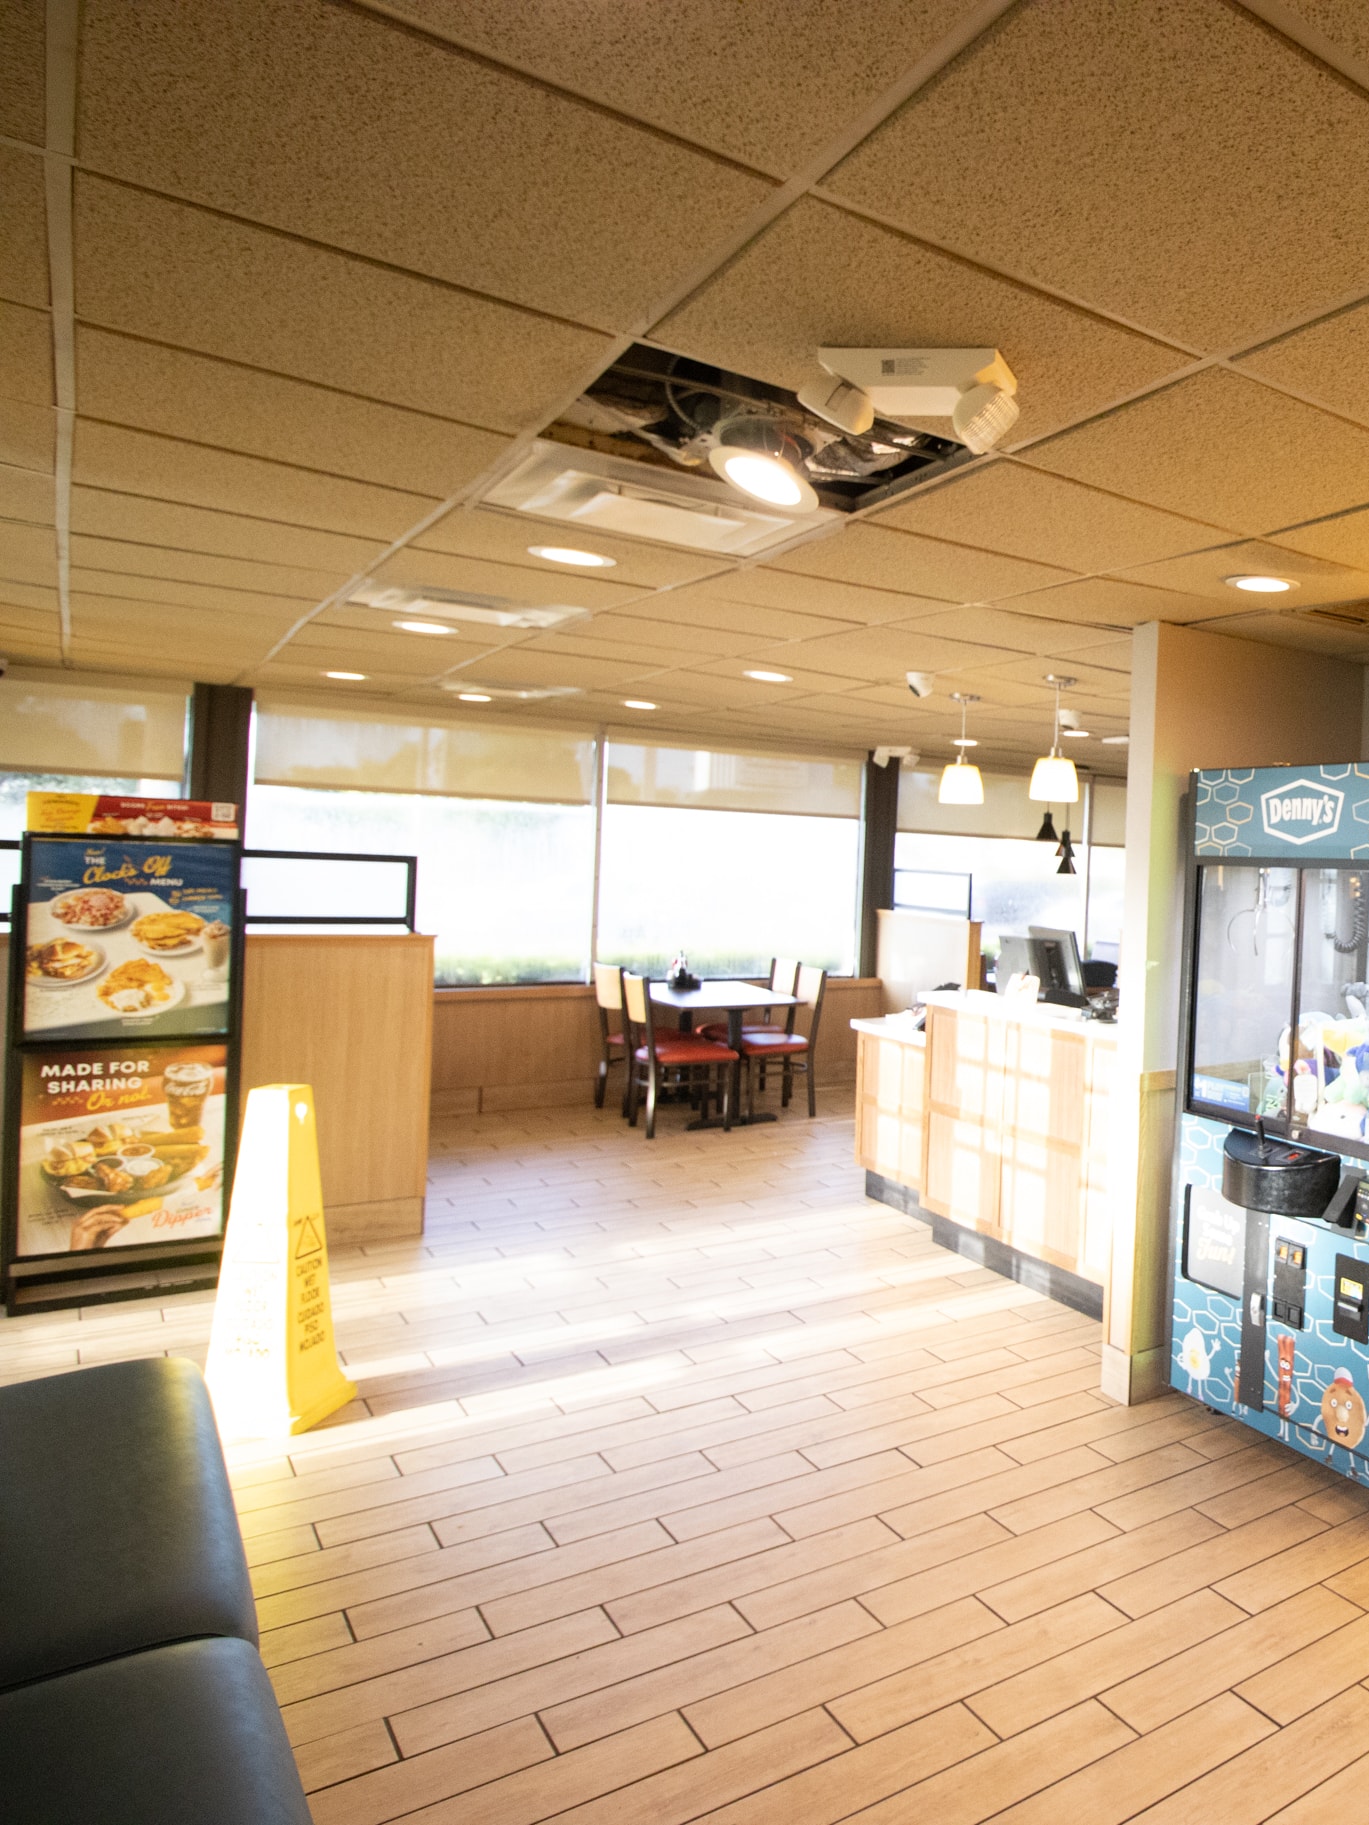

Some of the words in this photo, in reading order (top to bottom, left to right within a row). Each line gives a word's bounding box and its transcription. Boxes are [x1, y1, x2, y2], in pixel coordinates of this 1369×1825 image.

[1269, 794, 1335, 826] Denny's
[84, 856, 106, 865] THE
[142, 855, 172, 877] Off
[150, 877, 184, 887] MENU
[40, 1062, 104, 1078] MADE
[109, 1060, 150, 1075] FOR
[47, 1076, 142, 1094] SHARING
[86, 1092, 114, 1111] Or
[296, 1258, 322, 1277] CAUTION
[304, 1273, 316, 1288] WET
[301, 1287, 320, 1304] FLOOR
[297, 1302, 324, 1324] CUIDADO
[304, 1319, 318, 1334] PISO
